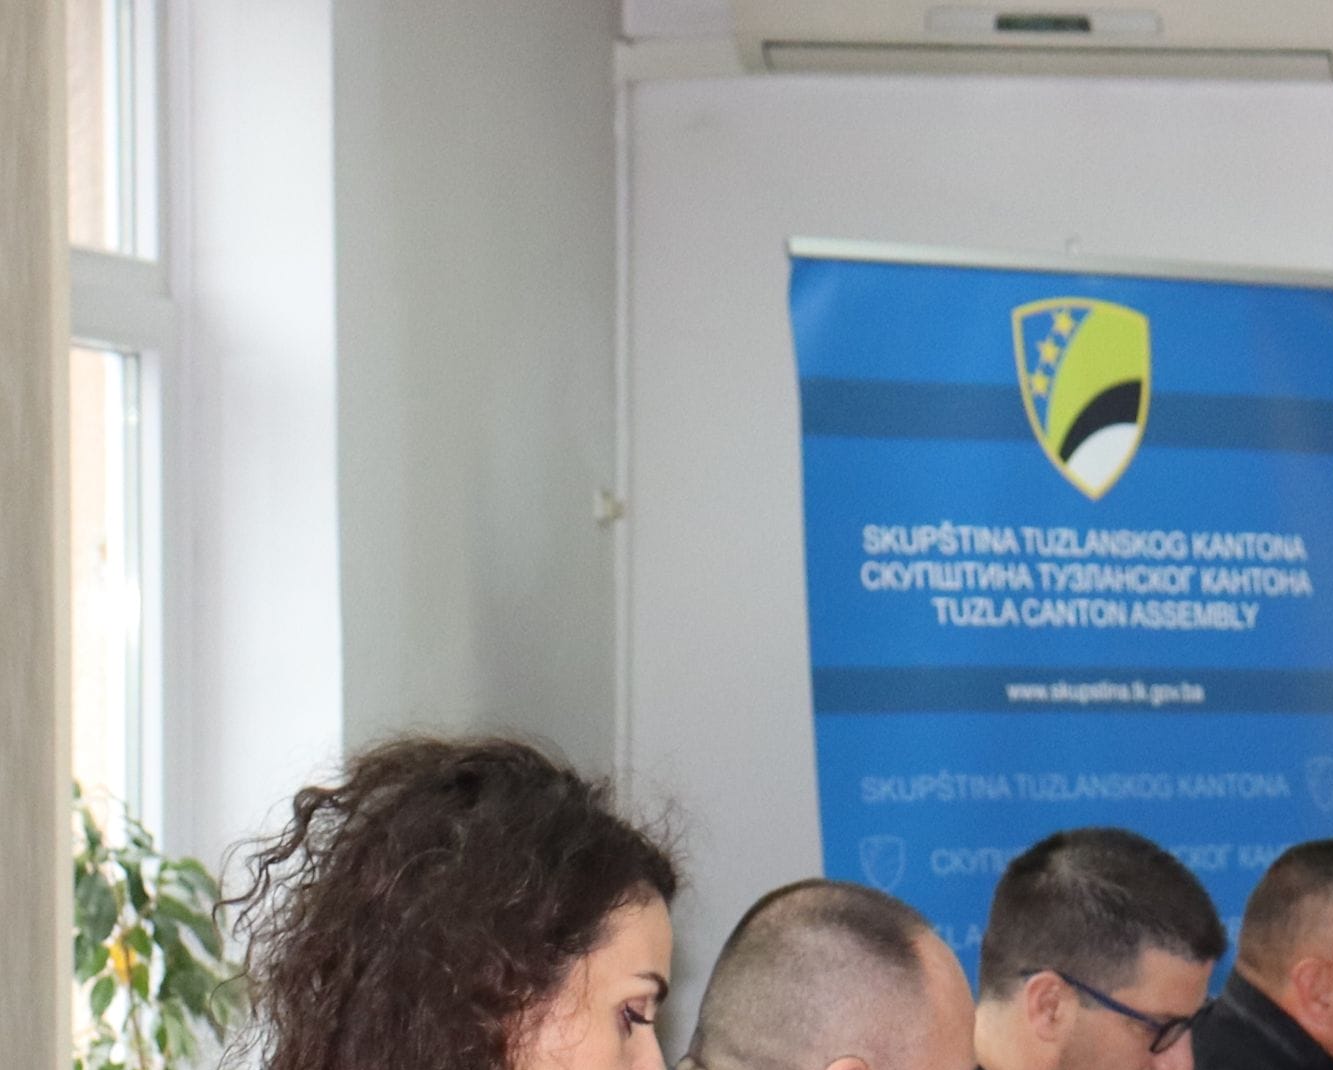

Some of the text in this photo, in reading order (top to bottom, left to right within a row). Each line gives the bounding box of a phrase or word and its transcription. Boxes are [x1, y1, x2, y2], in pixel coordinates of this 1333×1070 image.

[862, 519, 1308, 563] SKUPŠTINA TUZLANSKOG KANTONA
[860, 560, 1314, 598] СКУПШТИНА ТУЗЛАНСКОГ КАНТОНА
[931, 596, 1260, 632] TUZLA CANTON ASSEMBLY
[861, 769, 1291, 803] SKUPŠTINA TUZLANSKOG KANTONA
